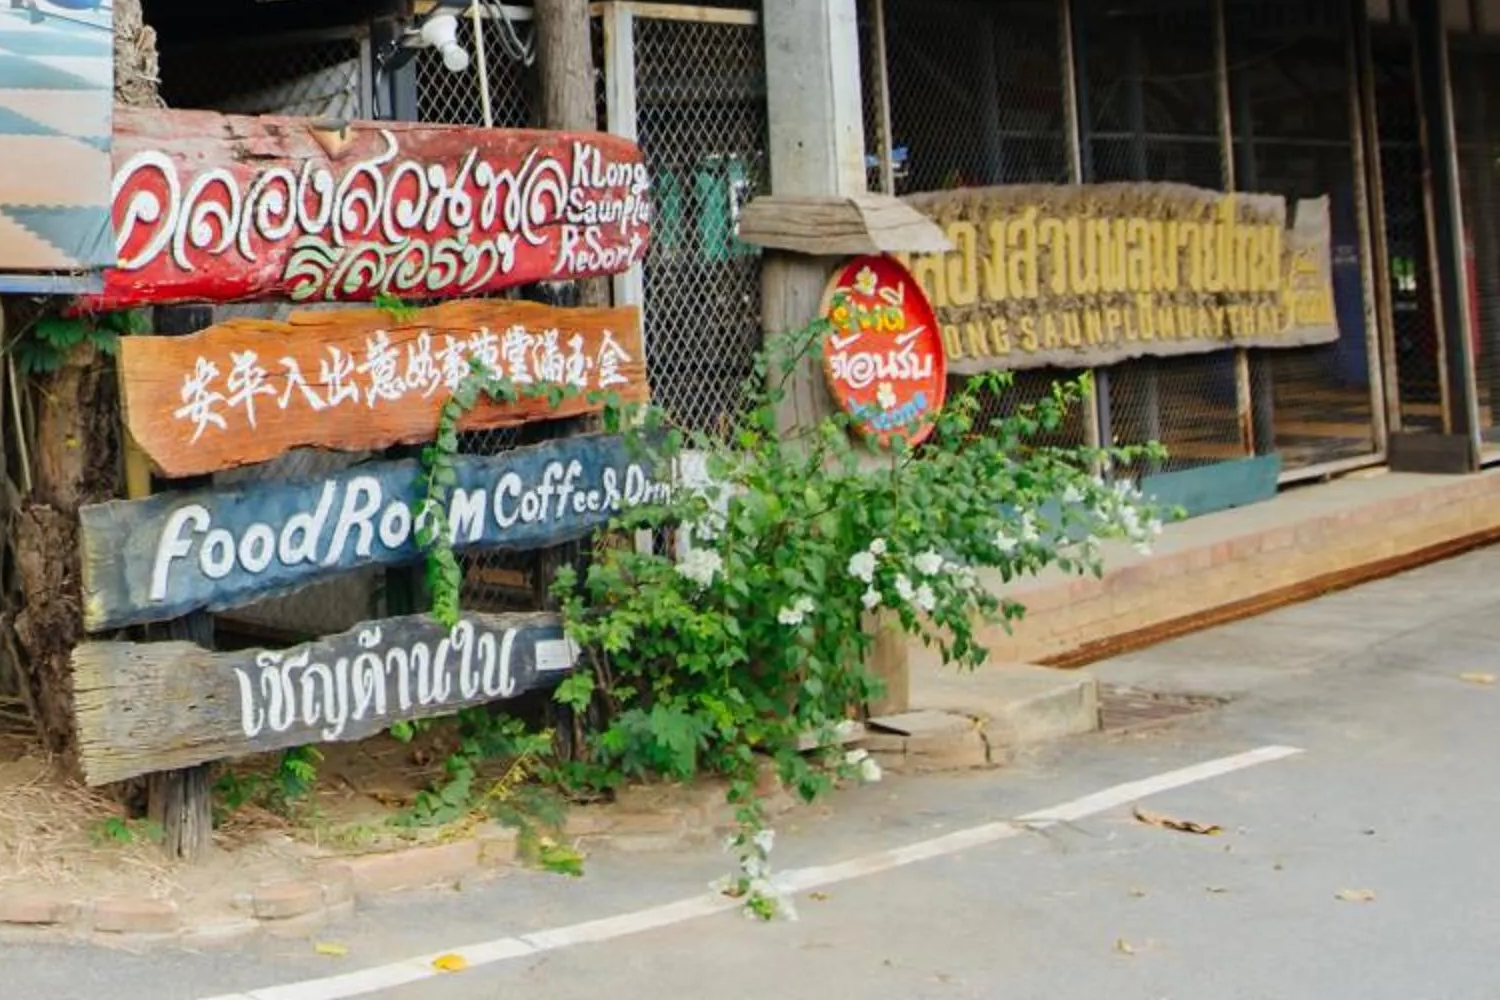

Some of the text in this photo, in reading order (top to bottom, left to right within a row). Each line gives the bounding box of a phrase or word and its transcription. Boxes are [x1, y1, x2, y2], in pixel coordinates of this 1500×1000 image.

[828, 325, 934, 389] ต้อนรับ
[233, 620, 516, 742] เชิญด้านใน
